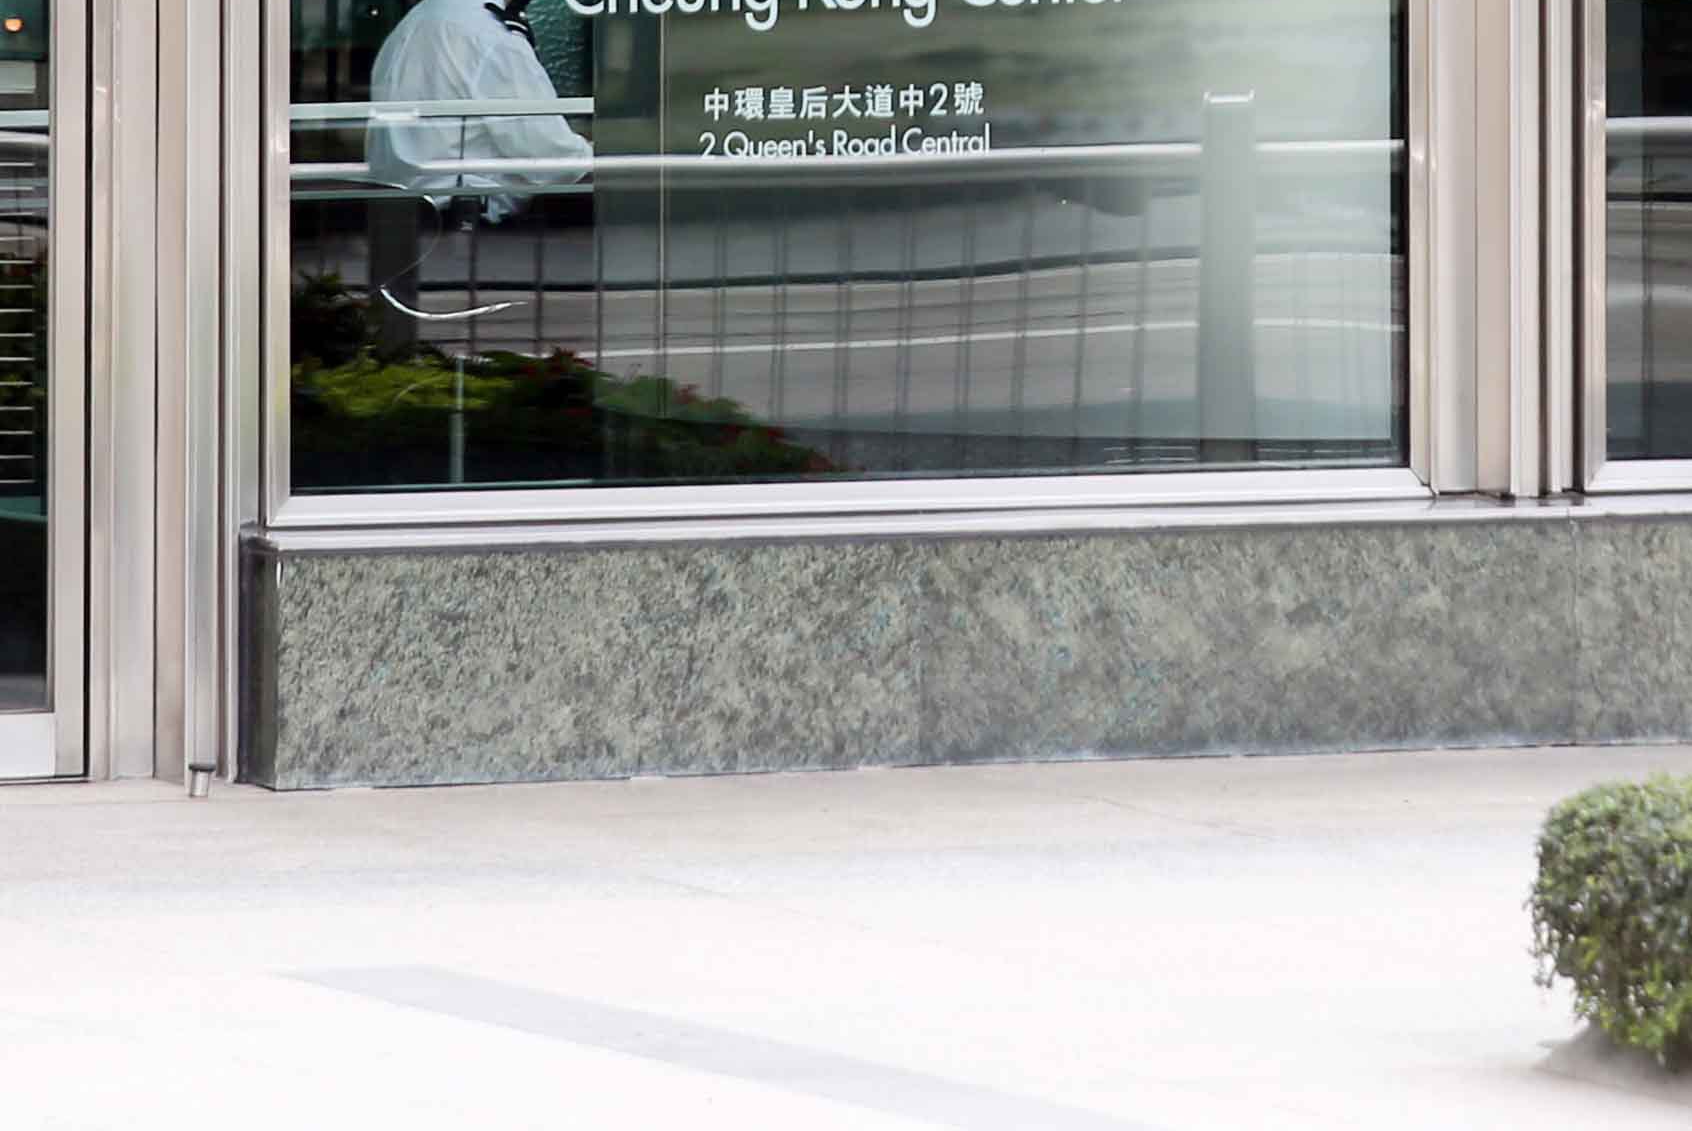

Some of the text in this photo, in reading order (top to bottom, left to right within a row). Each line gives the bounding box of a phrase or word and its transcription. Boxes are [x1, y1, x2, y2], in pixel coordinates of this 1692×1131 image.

[704, 81, 985, 121] 中環皇后大道中2號
[699, 122, 991, 158] 2 Queen's Road Central
